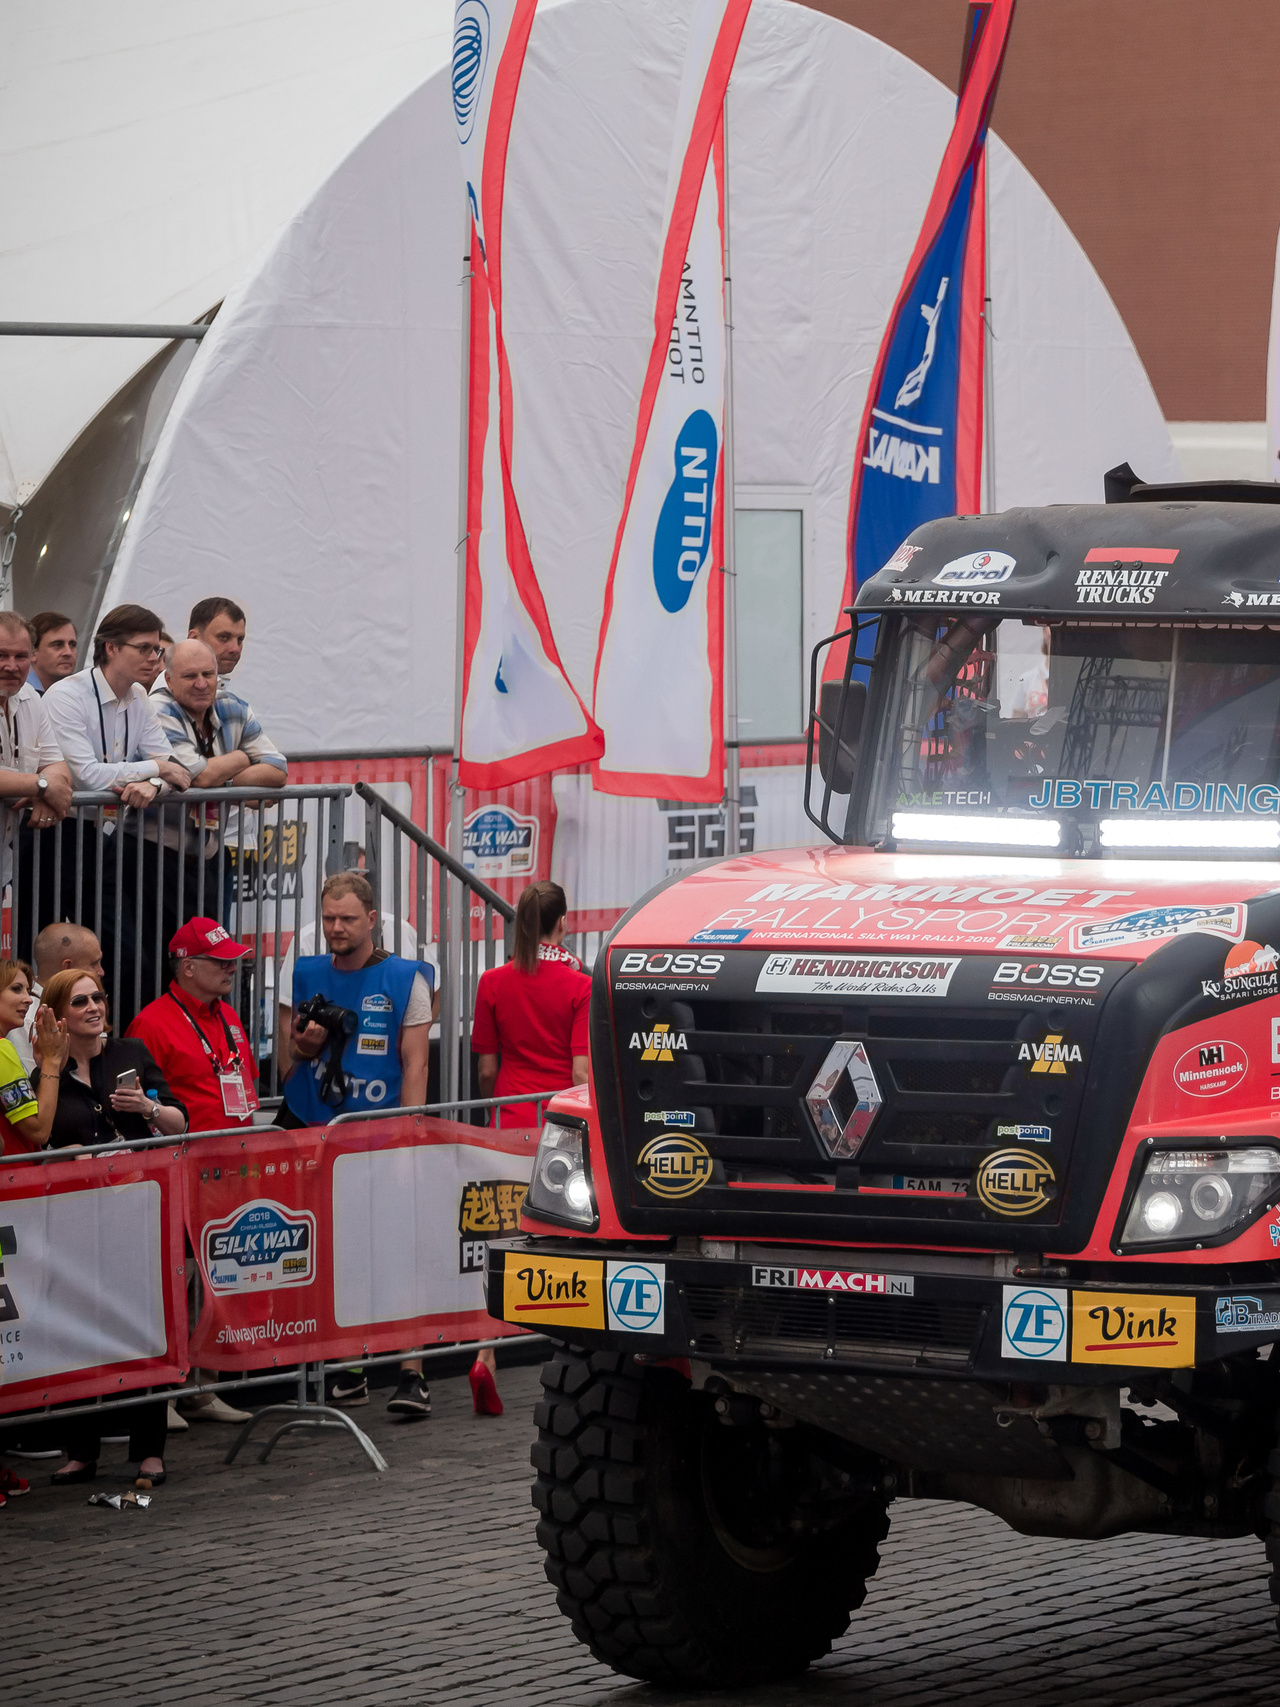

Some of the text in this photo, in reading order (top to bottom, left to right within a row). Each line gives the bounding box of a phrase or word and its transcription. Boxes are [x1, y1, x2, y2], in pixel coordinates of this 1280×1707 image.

[941, 565, 1010, 581] eurol
[1075, 569, 1169, 587] RENAULT
[904, 590, 1001, 605] MERITOR
[1076, 586, 1156, 604] TRUCKS
[897, 790, 991, 806] AXLETECH
[1029, 779, 1280, 815] JBTRADING
[495, 830, 529, 846] WAY
[744, 883, 1136, 908] MAMMOET
[703, 906, 1101, 935] RALLYSPORT
[1089, 915, 1156, 935] SILK
[1163, 907, 1227, 923] WAY
[751, 931, 996, 944] INTERNATIONAL SILK WAY RALLY 2018
[1136, 926, 1180, 940] 304
[619, 953, 725, 973] BOSS
[788, 958, 954, 980] HENDRICKSON
[993, 962, 1105, 987] BOSS
[813, 981, 937, 994] The World Rides On Us
[1220, 986, 1279, 1001] SAFARI LODGE
[987, 992, 1096, 1006] BOSSMACHINERY.NL
[629, 1032, 688, 1050] AVEMA
[1018, 1043, 1082, 1062] AVEMA
[1199, 1080, 1227, 1091] HARSKAMP
[644, 1111, 688, 1123] postpoint
[998, 1125, 1044, 1137] postpoint
[648, 1156, 709, 1175] HELLA
[248, 1212, 270, 1222] 2018
[213, 1228, 305, 1256] SILK WAY
[240, 1251, 277, 1263] RALLY
[516, 1266, 588, 1302] Vink
[754, 1268, 914, 1296] FRIMACH.NL
[613, 1277, 660, 1318] ZF
[216, 1318, 317, 1345] silkwayrally.com
[1010, 1302, 1062, 1344] ZF
[1088, 1305, 1177, 1342] Vink
